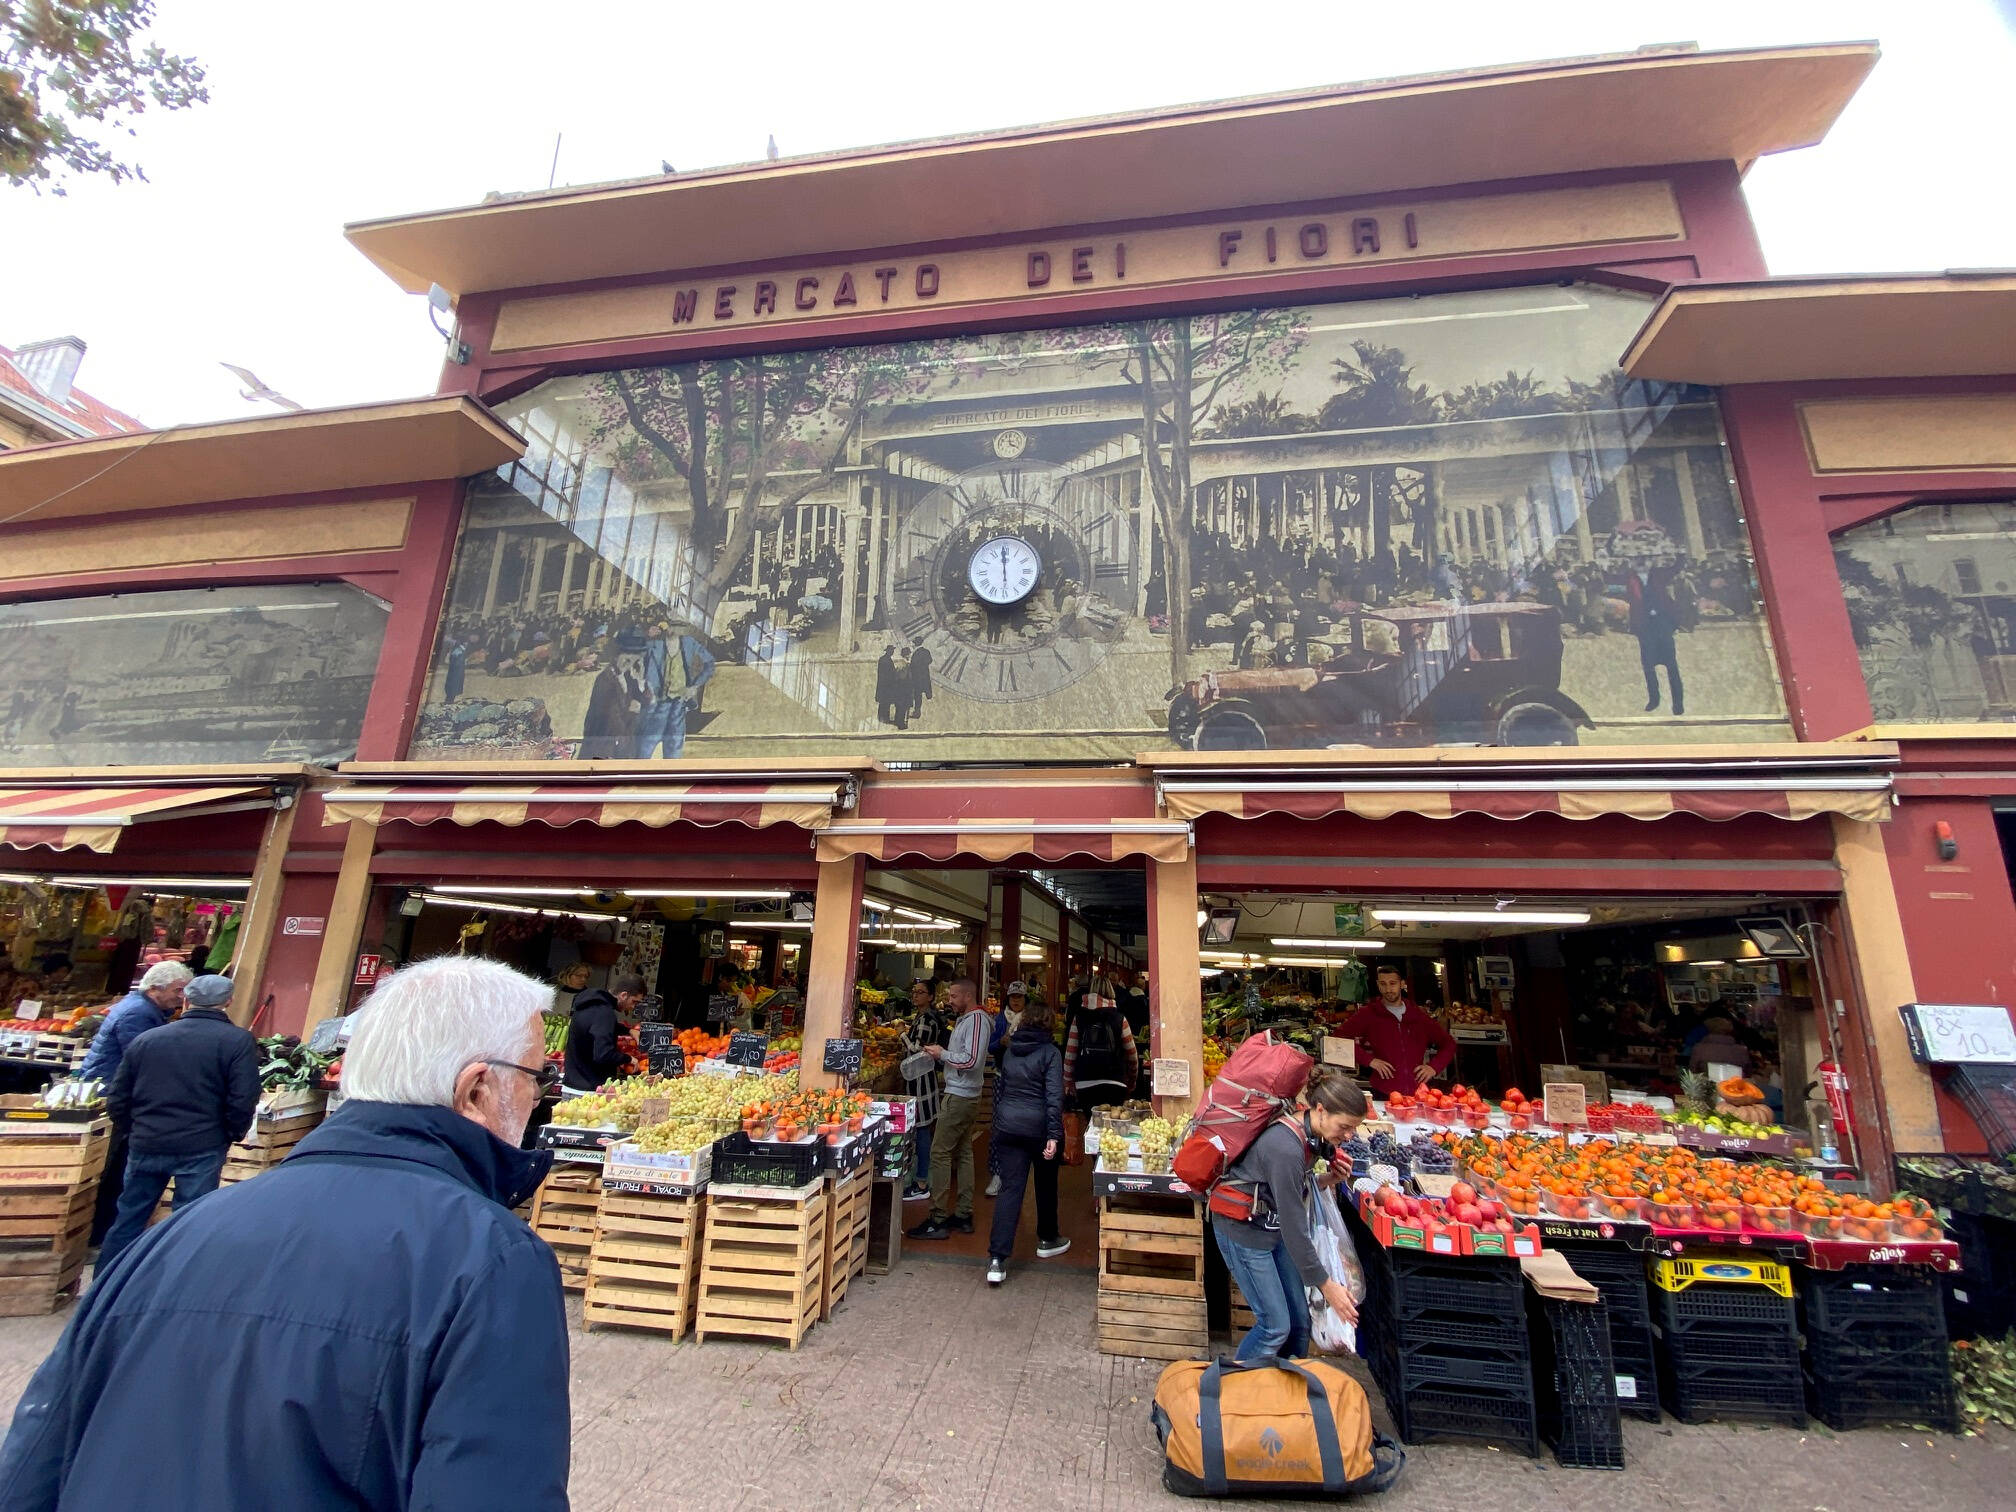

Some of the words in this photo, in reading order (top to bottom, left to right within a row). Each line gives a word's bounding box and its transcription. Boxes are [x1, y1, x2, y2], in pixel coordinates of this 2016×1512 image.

[672, 264, 940, 323] MERCATO
[1027, 242, 1125, 287] DEI
[1220, 212, 1418, 266] FIORI
[945, 410, 1007, 425] MERCATO
[1016, 407, 1038, 419] DEI
[1720, 1138, 1750, 1149] Volley
[645, 1169, 654, 1177] di
[615, 1181, 641, 1192] FRUIT
[654, 1184, 683, 1195] ROYAL
[1544, 1226, 1573, 1238] Fresh
[1580, 1227, 1599, 1239] Nat
[1868, 1247, 1907, 1262] Volley
